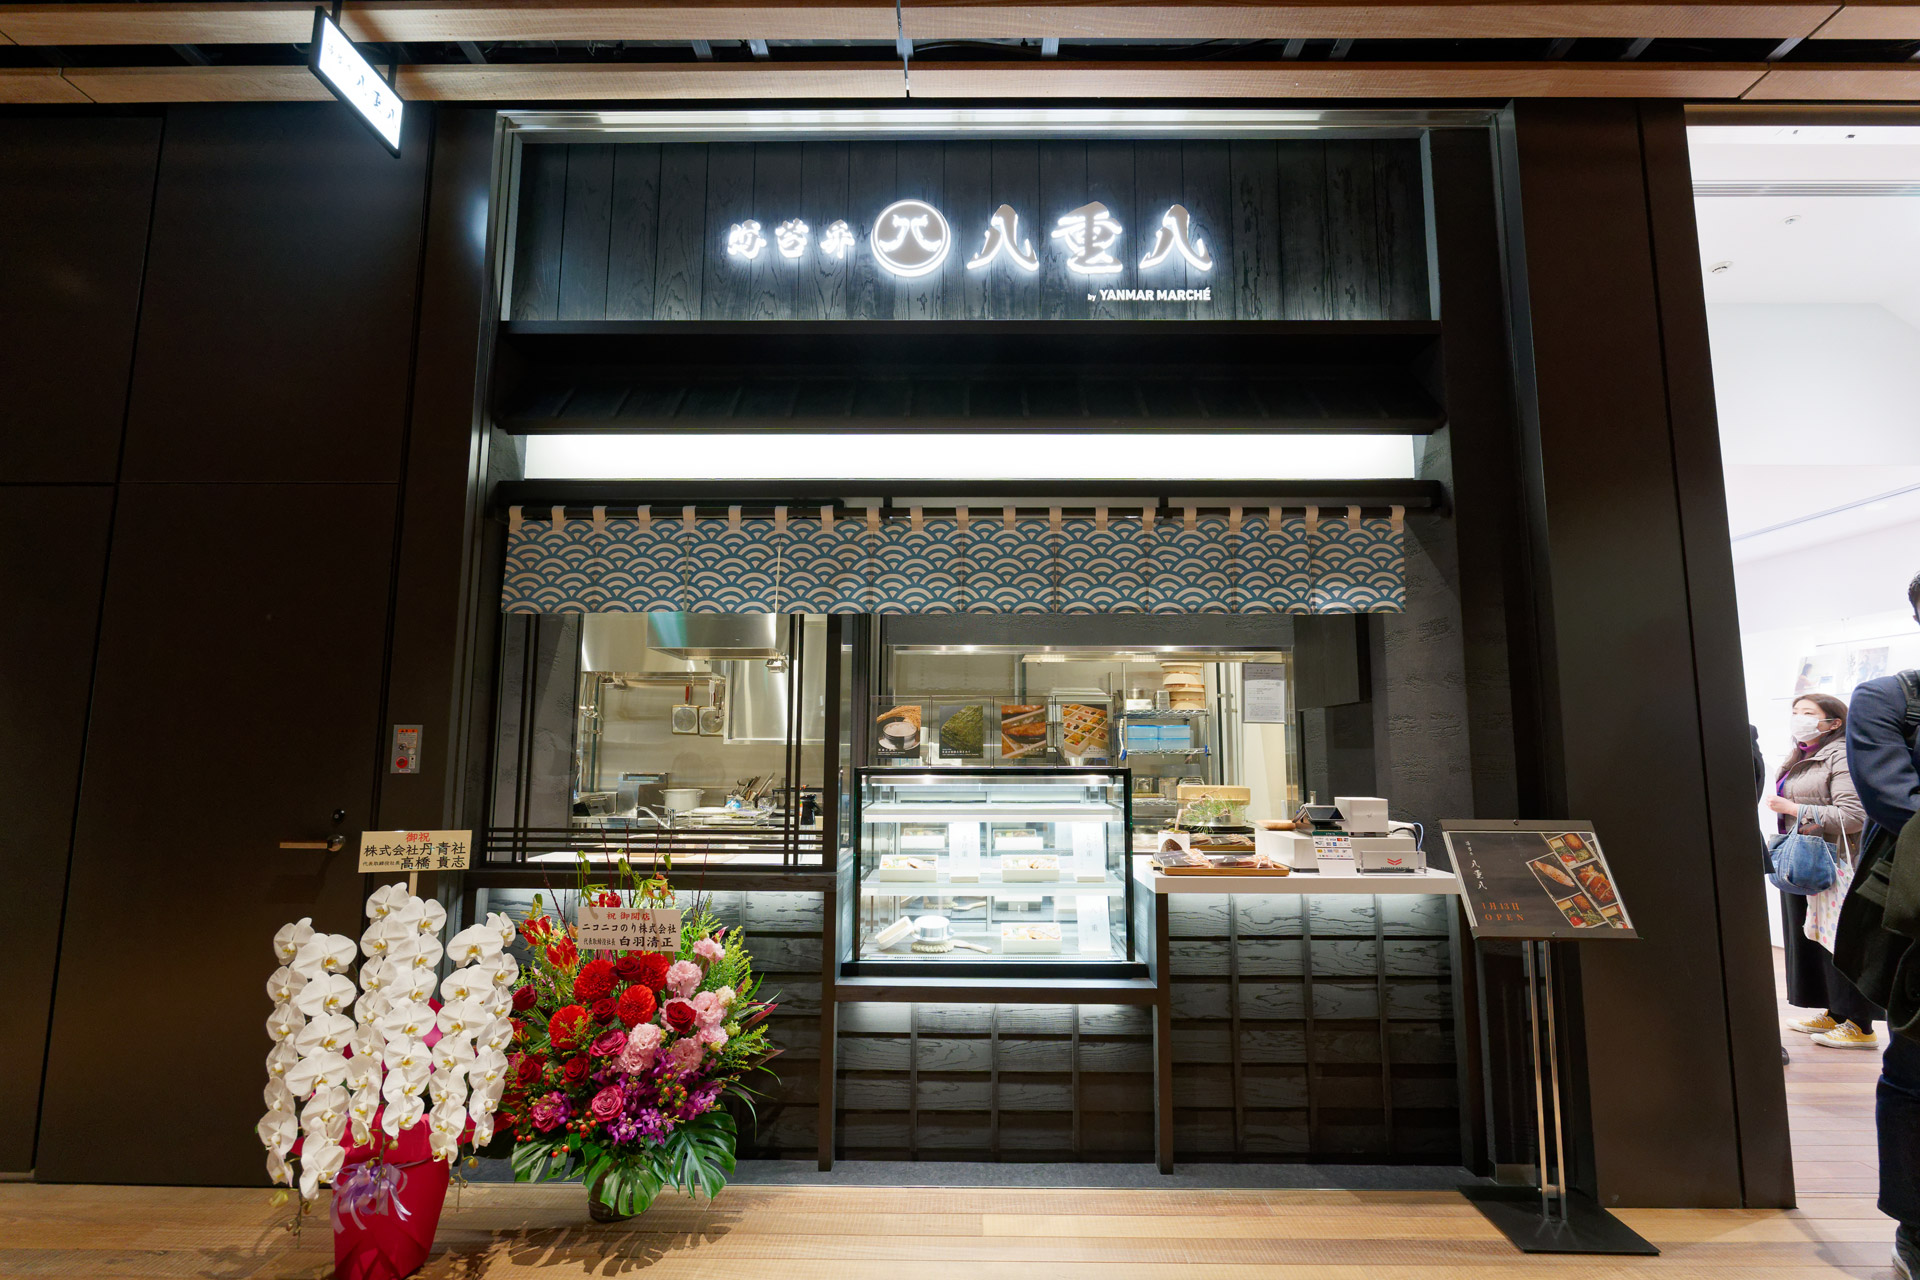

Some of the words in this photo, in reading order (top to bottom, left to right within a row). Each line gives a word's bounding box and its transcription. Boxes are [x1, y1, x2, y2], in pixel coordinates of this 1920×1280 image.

[966, 201, 1213, 274] 八重八
[1087, 293, 1097, 301] by
[1100, 289, 1154, 301] YANMAR
[1156, 287, 1211, 301] MARCHÉ
[406, 832, 431, 843] 御祝
[363, 841, 466, 857] 株式会社丹青社
[606, 911, 617, 921] 祝
[620, 911, 651, 921] 御開店
[1484, 913, 1525, 921] OPEN
[582, 923, 677, 935] ニコニコのり株式会社
[619, 936, 674, 948] 白羽清正
